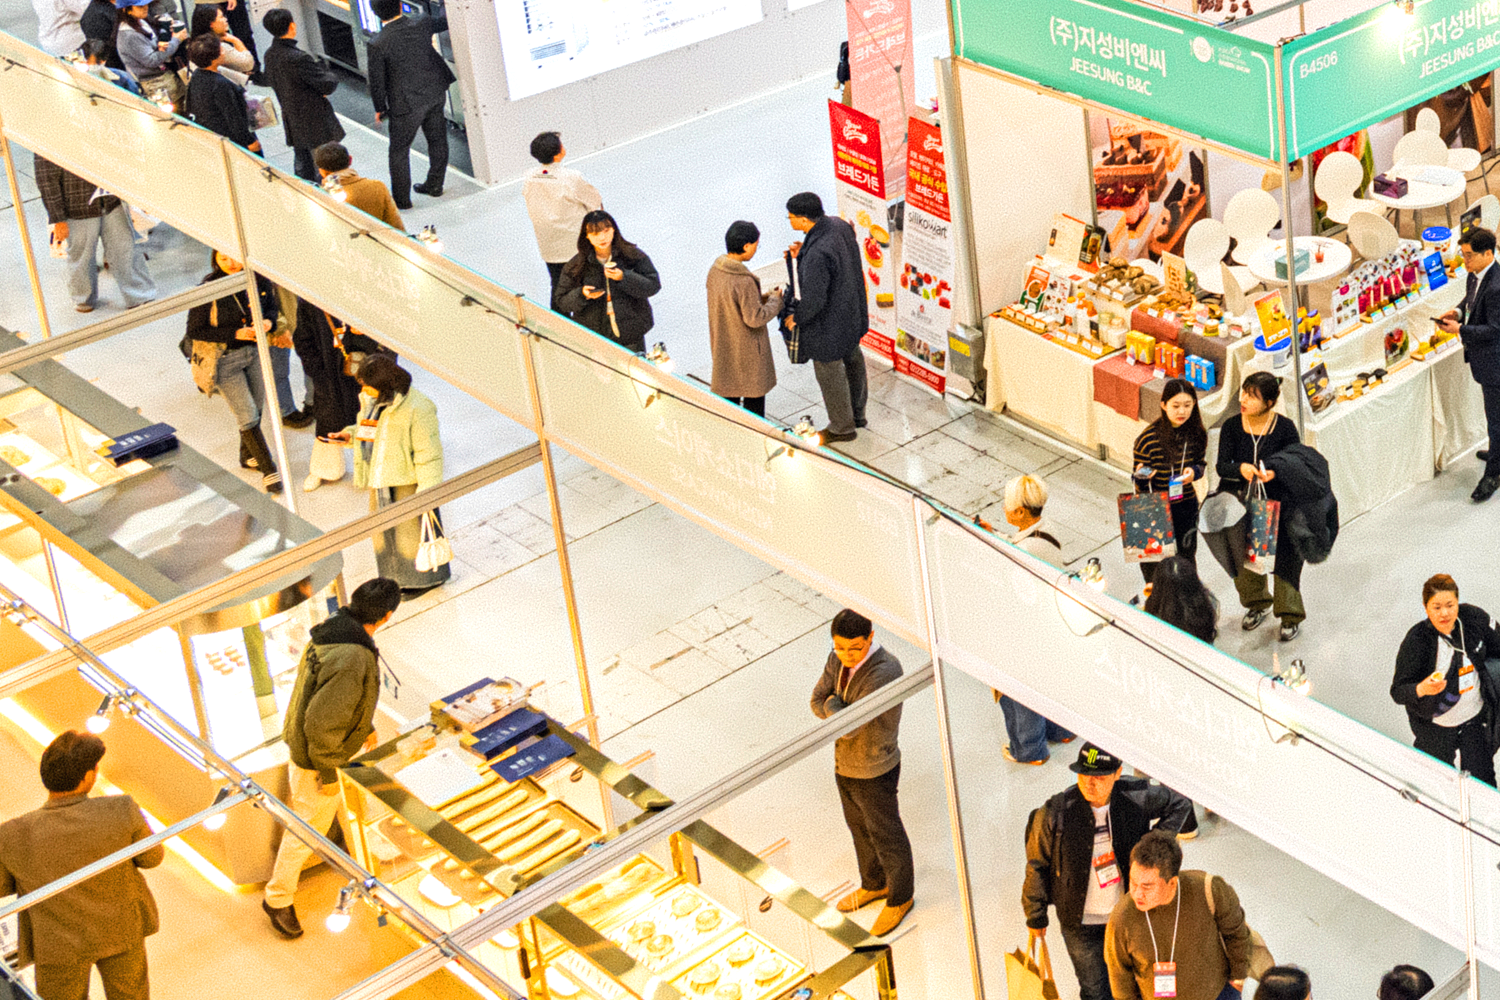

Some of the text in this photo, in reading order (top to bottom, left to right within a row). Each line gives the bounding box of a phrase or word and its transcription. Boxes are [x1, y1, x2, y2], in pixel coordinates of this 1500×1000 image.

[1049, 15, 1166, 78] (주)지성비앤씨
[1419, 30, 1500, 80] JEESUNG B&C
[1070, 56, 1152, 96] JEESUNG B&C
[1300, 50, 1338, 79] B4506
[838, 161, 879, 192] 브레드가든
[915, 184, 944, 204] 브레드가든
